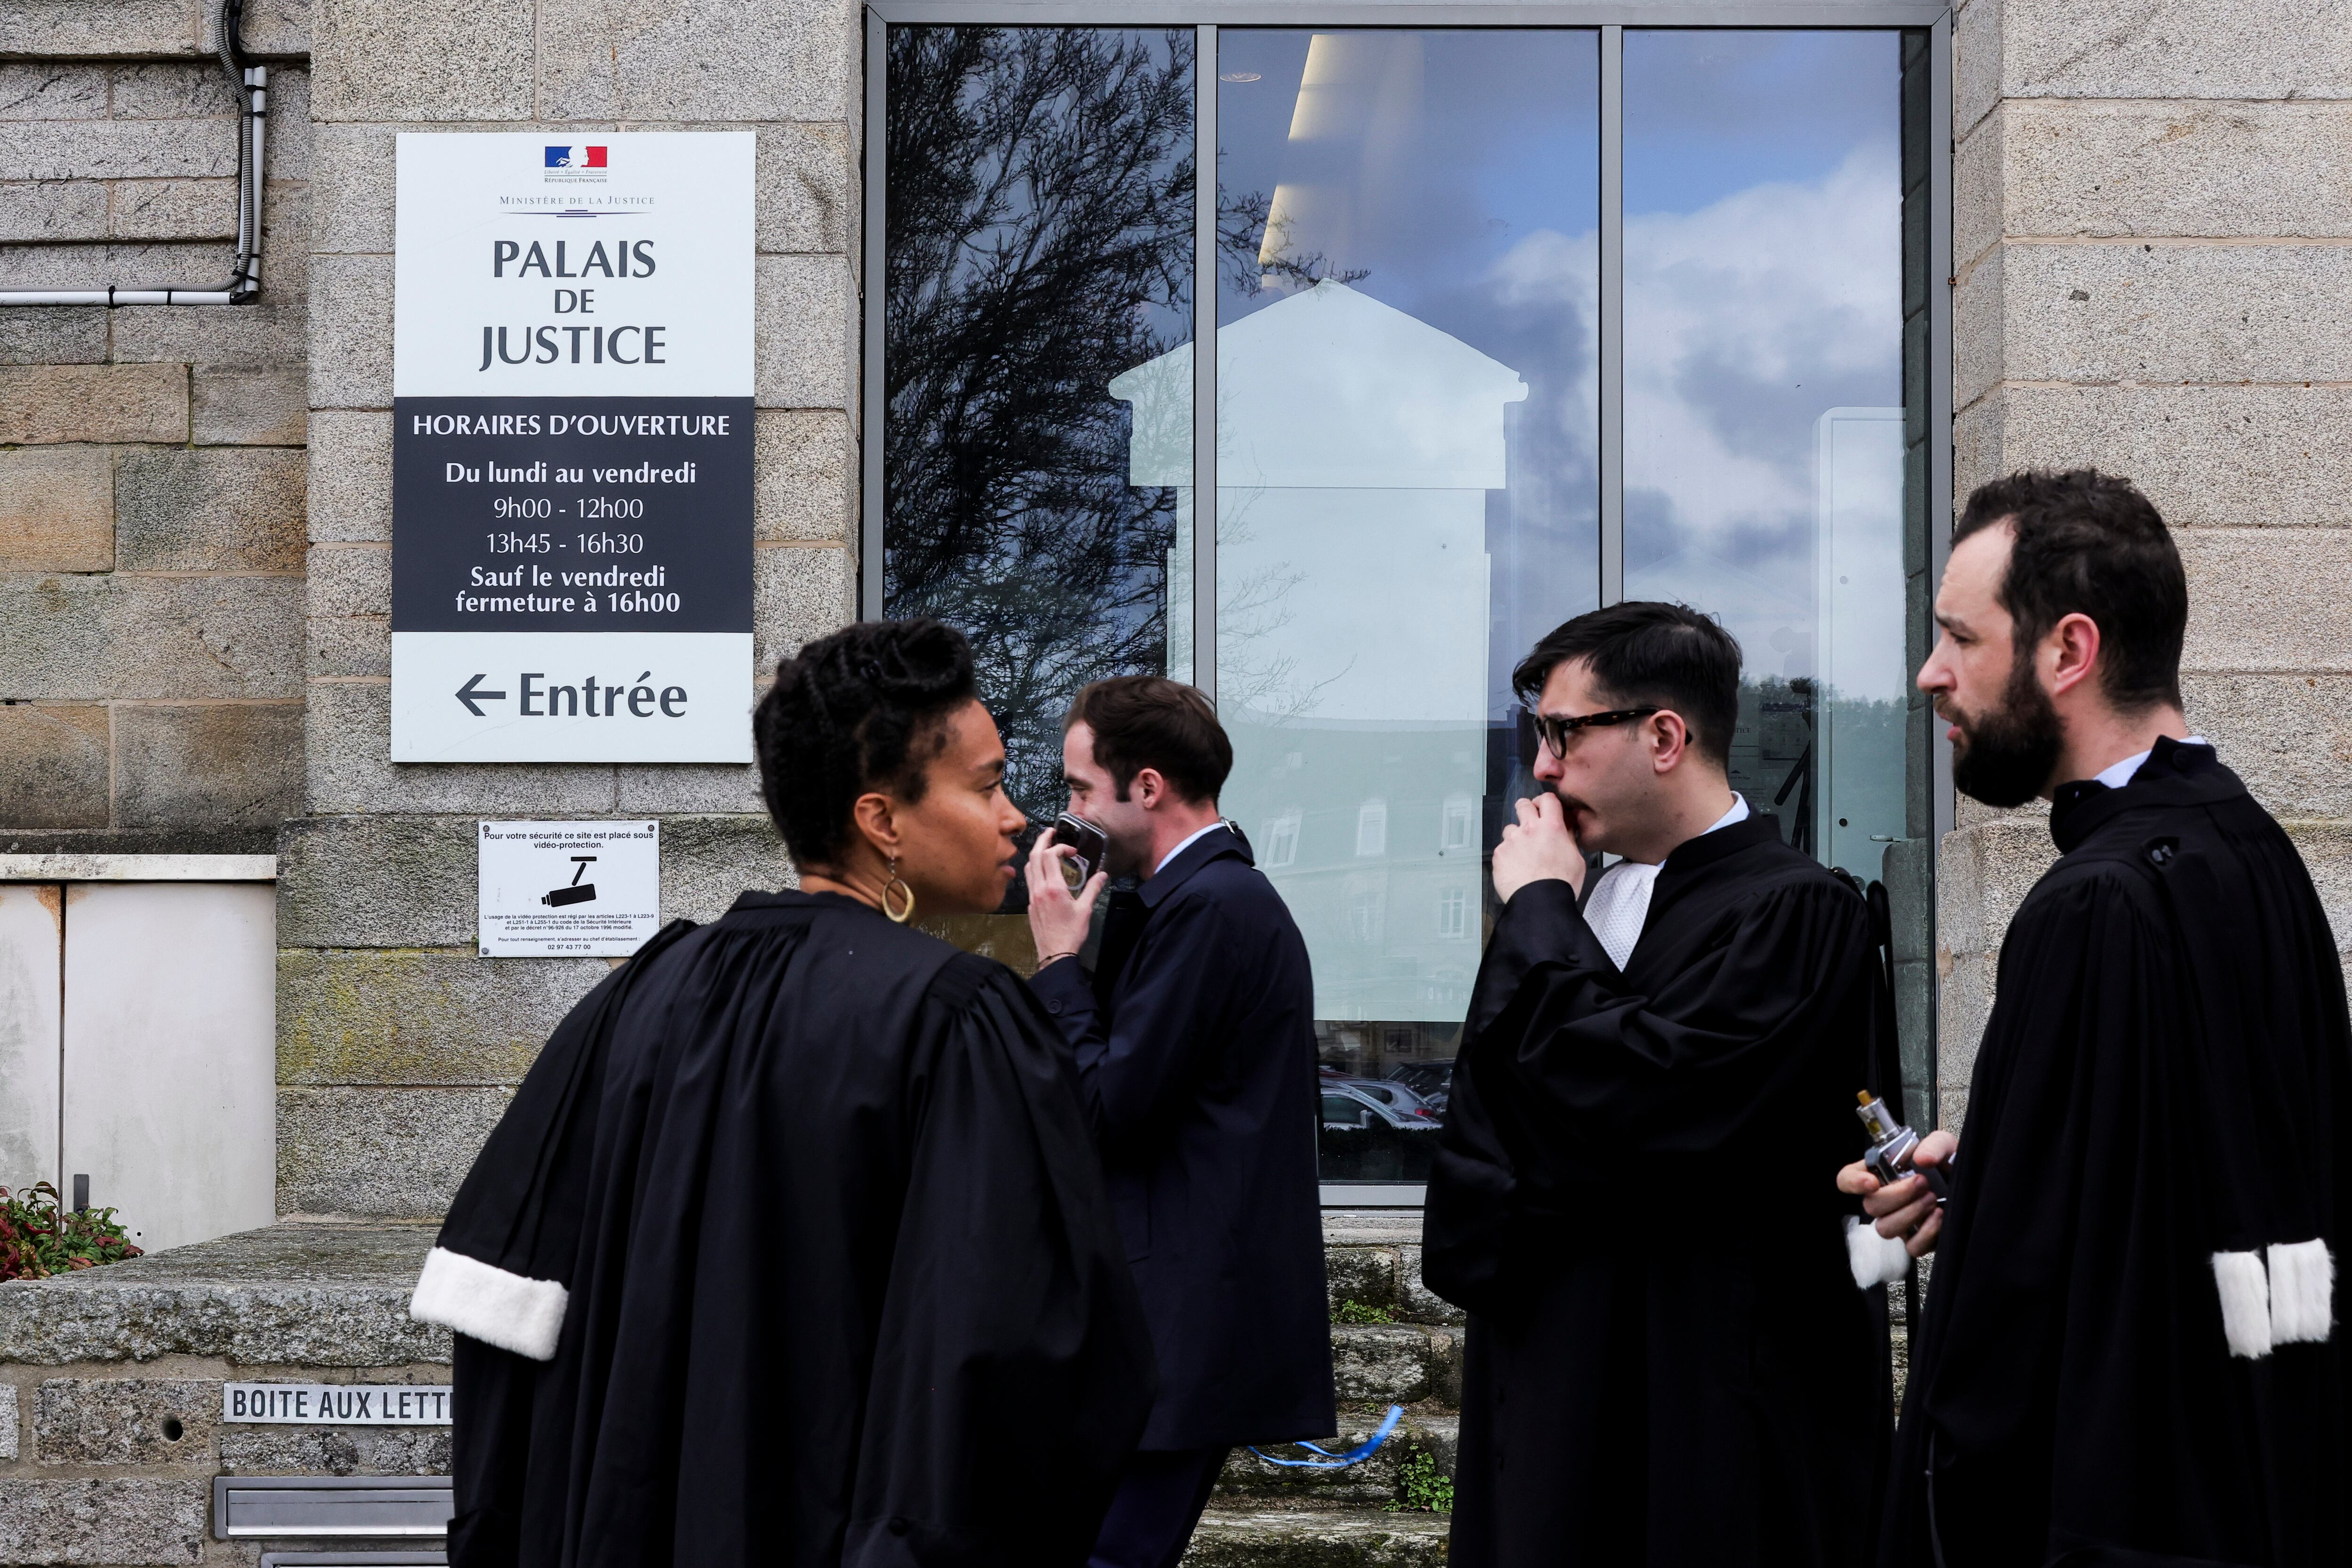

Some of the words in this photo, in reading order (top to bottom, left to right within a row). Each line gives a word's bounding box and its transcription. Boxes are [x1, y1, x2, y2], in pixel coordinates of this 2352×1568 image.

[500, 195, 564, 205] MINISTÈRE
[607, 196, 654, 204] JUSTICE
[494, 239, 656, 279] PALAIS
[554, 289, 595, 313] DE
[478, 326, 666, 372] JUSTICE
[413, 414, 541, 435] HORAIRES
[549, 415, 730, 436] D'OUVERTURE
[446, 462, 480, 483] Du
[488, 461, 547, 483] lundi
[555, 468, 583, 483] au
[592, 461, 696, 483] vendredi
[494, 496, 551, 518] 9h00
[577, 496, 644, 518] 12h00
[487, 531, 550, 553] 13h45
[577, 532, 643, 554] 16h30
[471, 565, 524, 587] Sauf
[532, 565, 552, 587] le
[561, 565, 665, 587] vendredi
[455, 590, 575, 612] fermeture
[583, 591, 597, 612] à
[608, 590, 680, 613] 16h00
[520, 670, 688, 718] Entrée
[533, 841, 604, 850] vidéo-protection.
[609, 831, 631, 841] placé
[233, 1389, 308, 1417] BOITE
[318, 1391, 372, 1419] AUX
[383, 1391, 453, 1419] LETT
